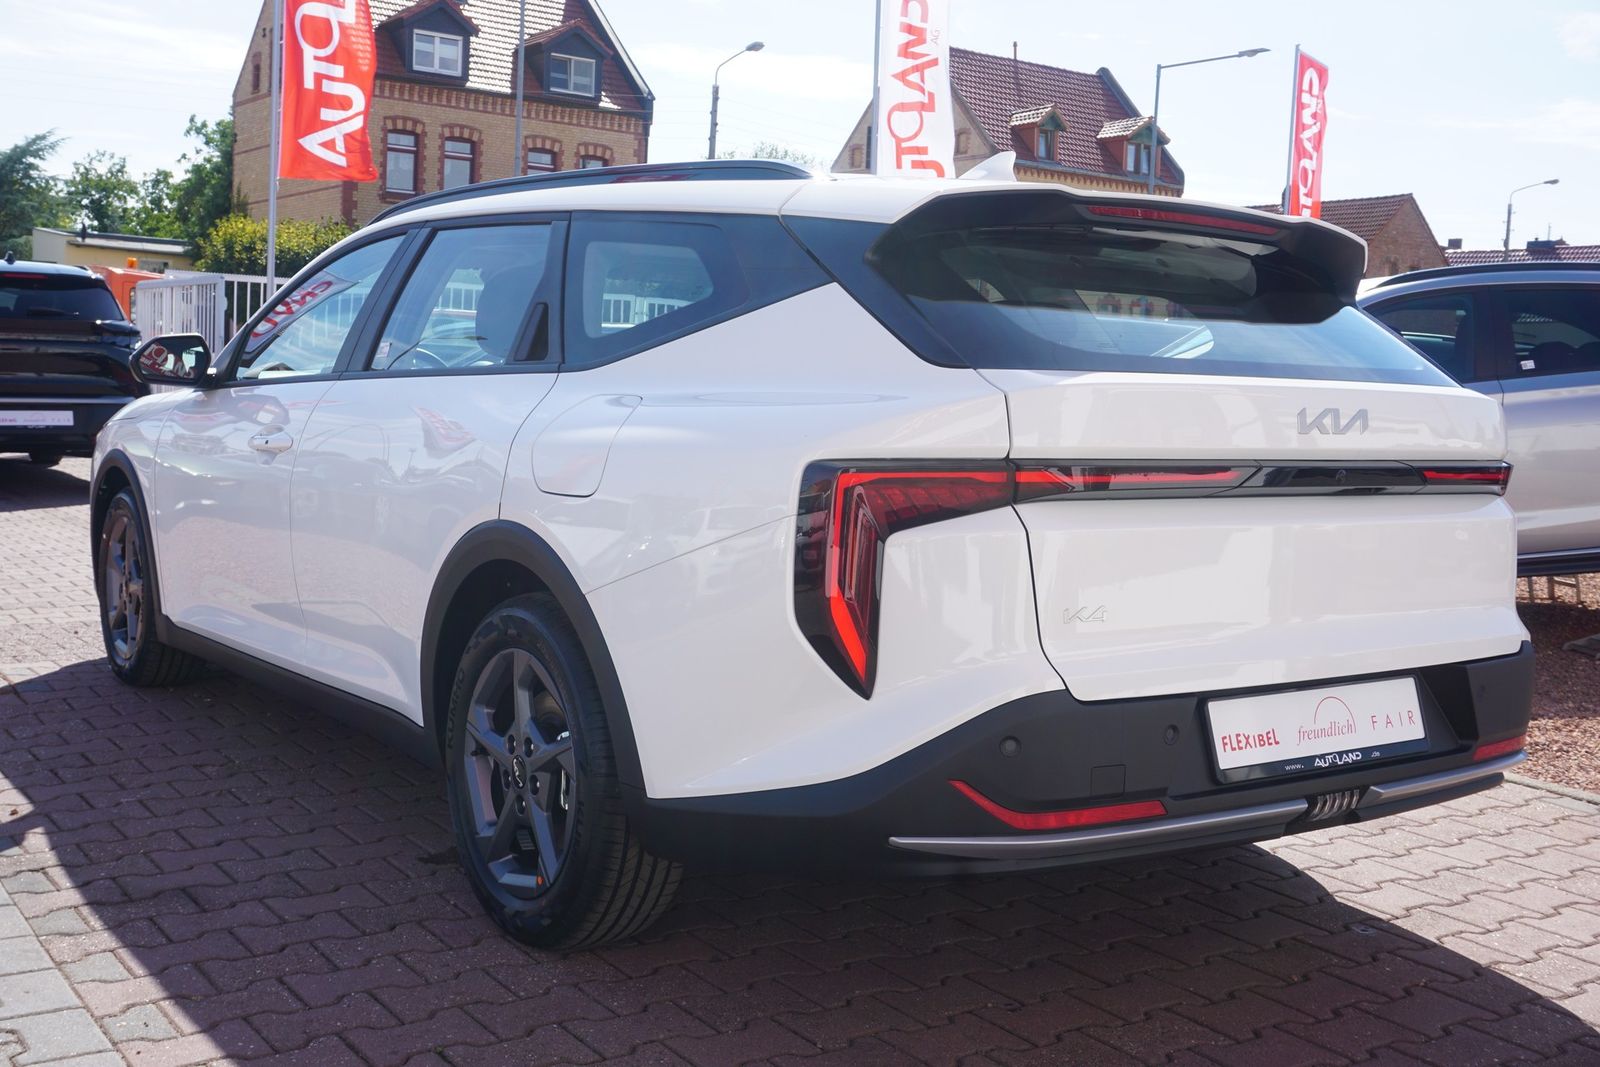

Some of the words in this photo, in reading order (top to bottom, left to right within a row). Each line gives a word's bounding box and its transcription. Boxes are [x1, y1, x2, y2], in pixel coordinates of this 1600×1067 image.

[930, 28, 940, 46] AG
[1296, 407, 1369, 434] KIA
[1063, 604, 1107, 624] K4
[1221, 728, 1280, 753] FLEXIBEL
[1296, 719, 1353, 746] freundlich
[1314, 751, 1362, 768] AUTOLAND
